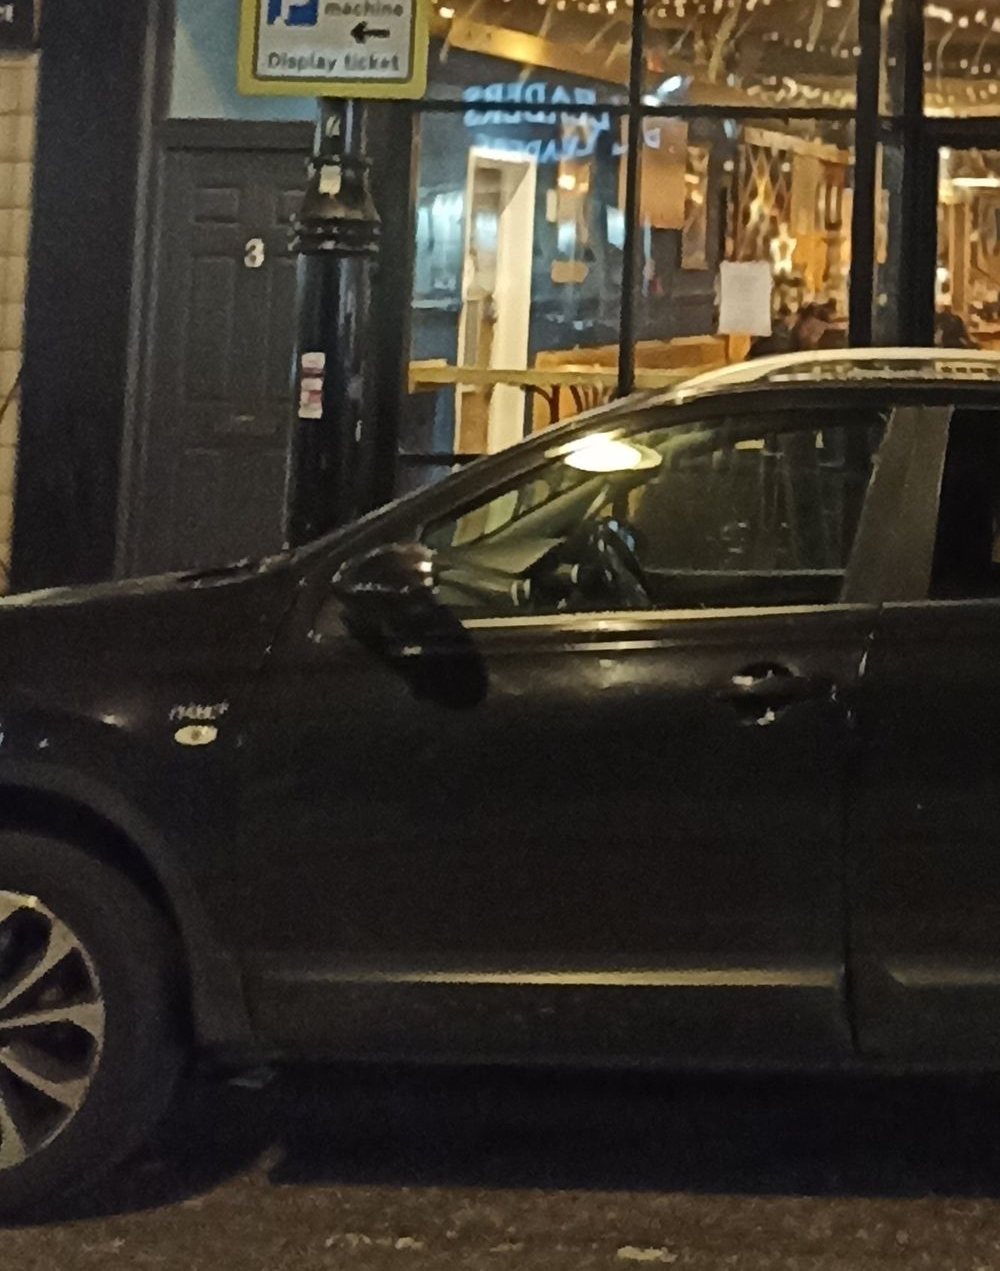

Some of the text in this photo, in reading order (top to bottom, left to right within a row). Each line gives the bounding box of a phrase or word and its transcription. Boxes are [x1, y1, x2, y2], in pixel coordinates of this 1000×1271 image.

[324, 0, 404, 17] machine
[267, 51, 400, 72] Display ticket
[244, 238, 264, 267] 3
